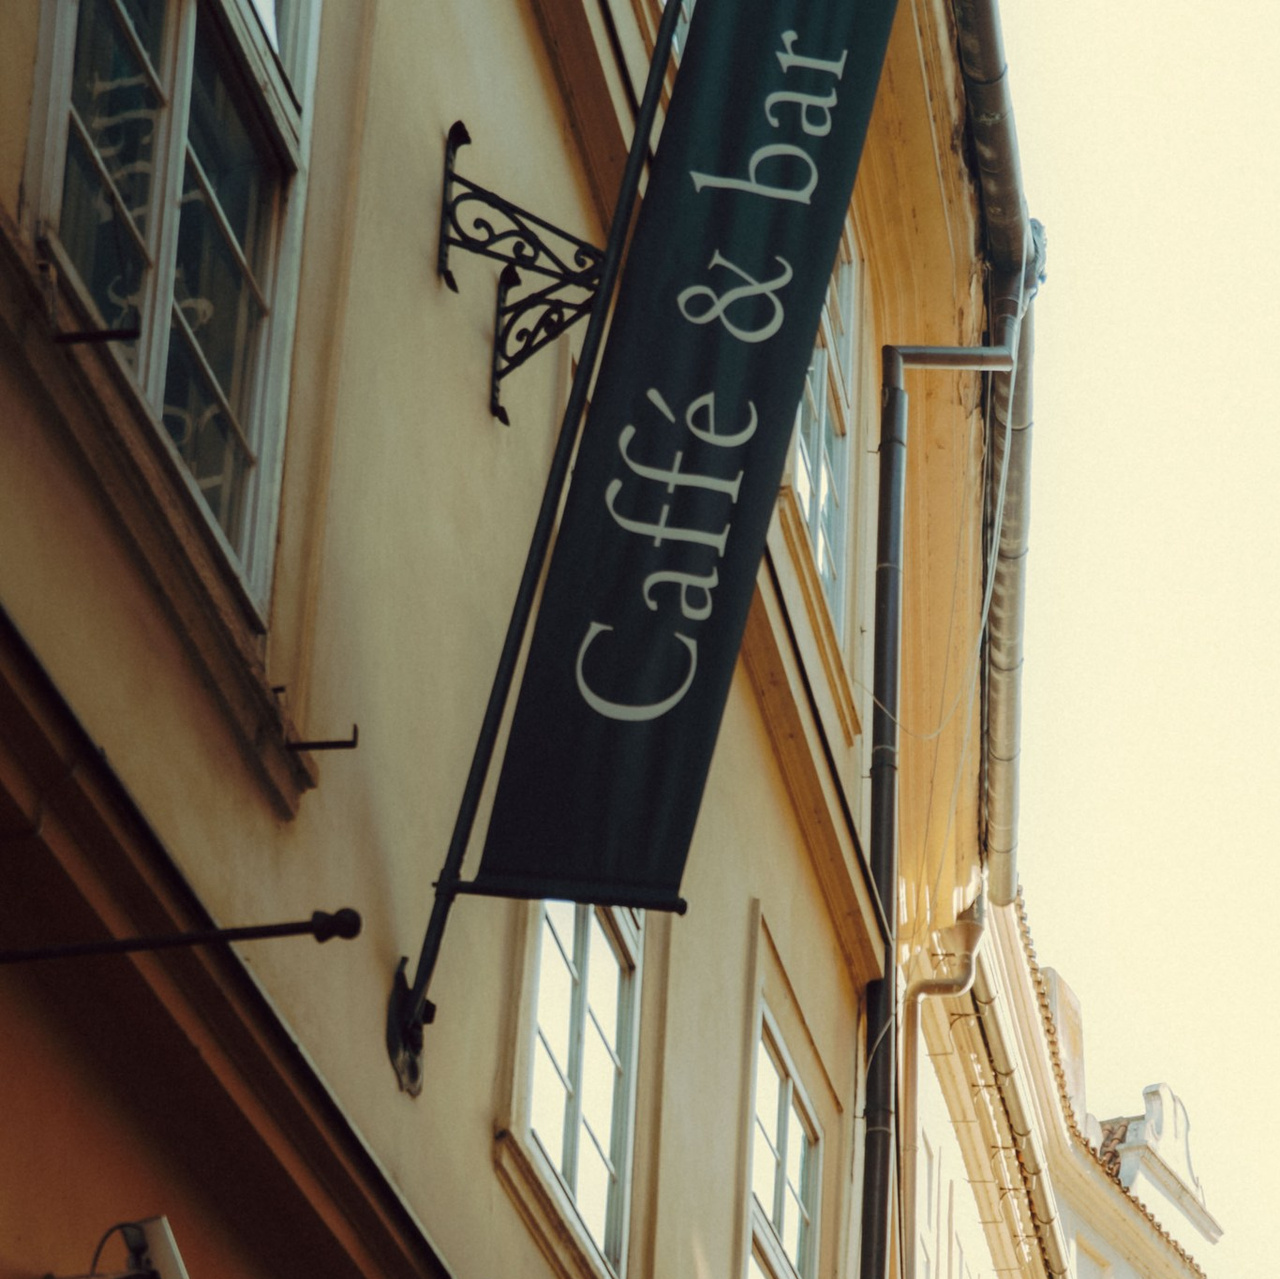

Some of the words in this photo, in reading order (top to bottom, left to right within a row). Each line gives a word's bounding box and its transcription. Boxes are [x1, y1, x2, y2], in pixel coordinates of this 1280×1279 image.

[689, 29, 849, 206] bar
[676, 250, 794, 344] &
[575, 387, 759, 723] Caffé
